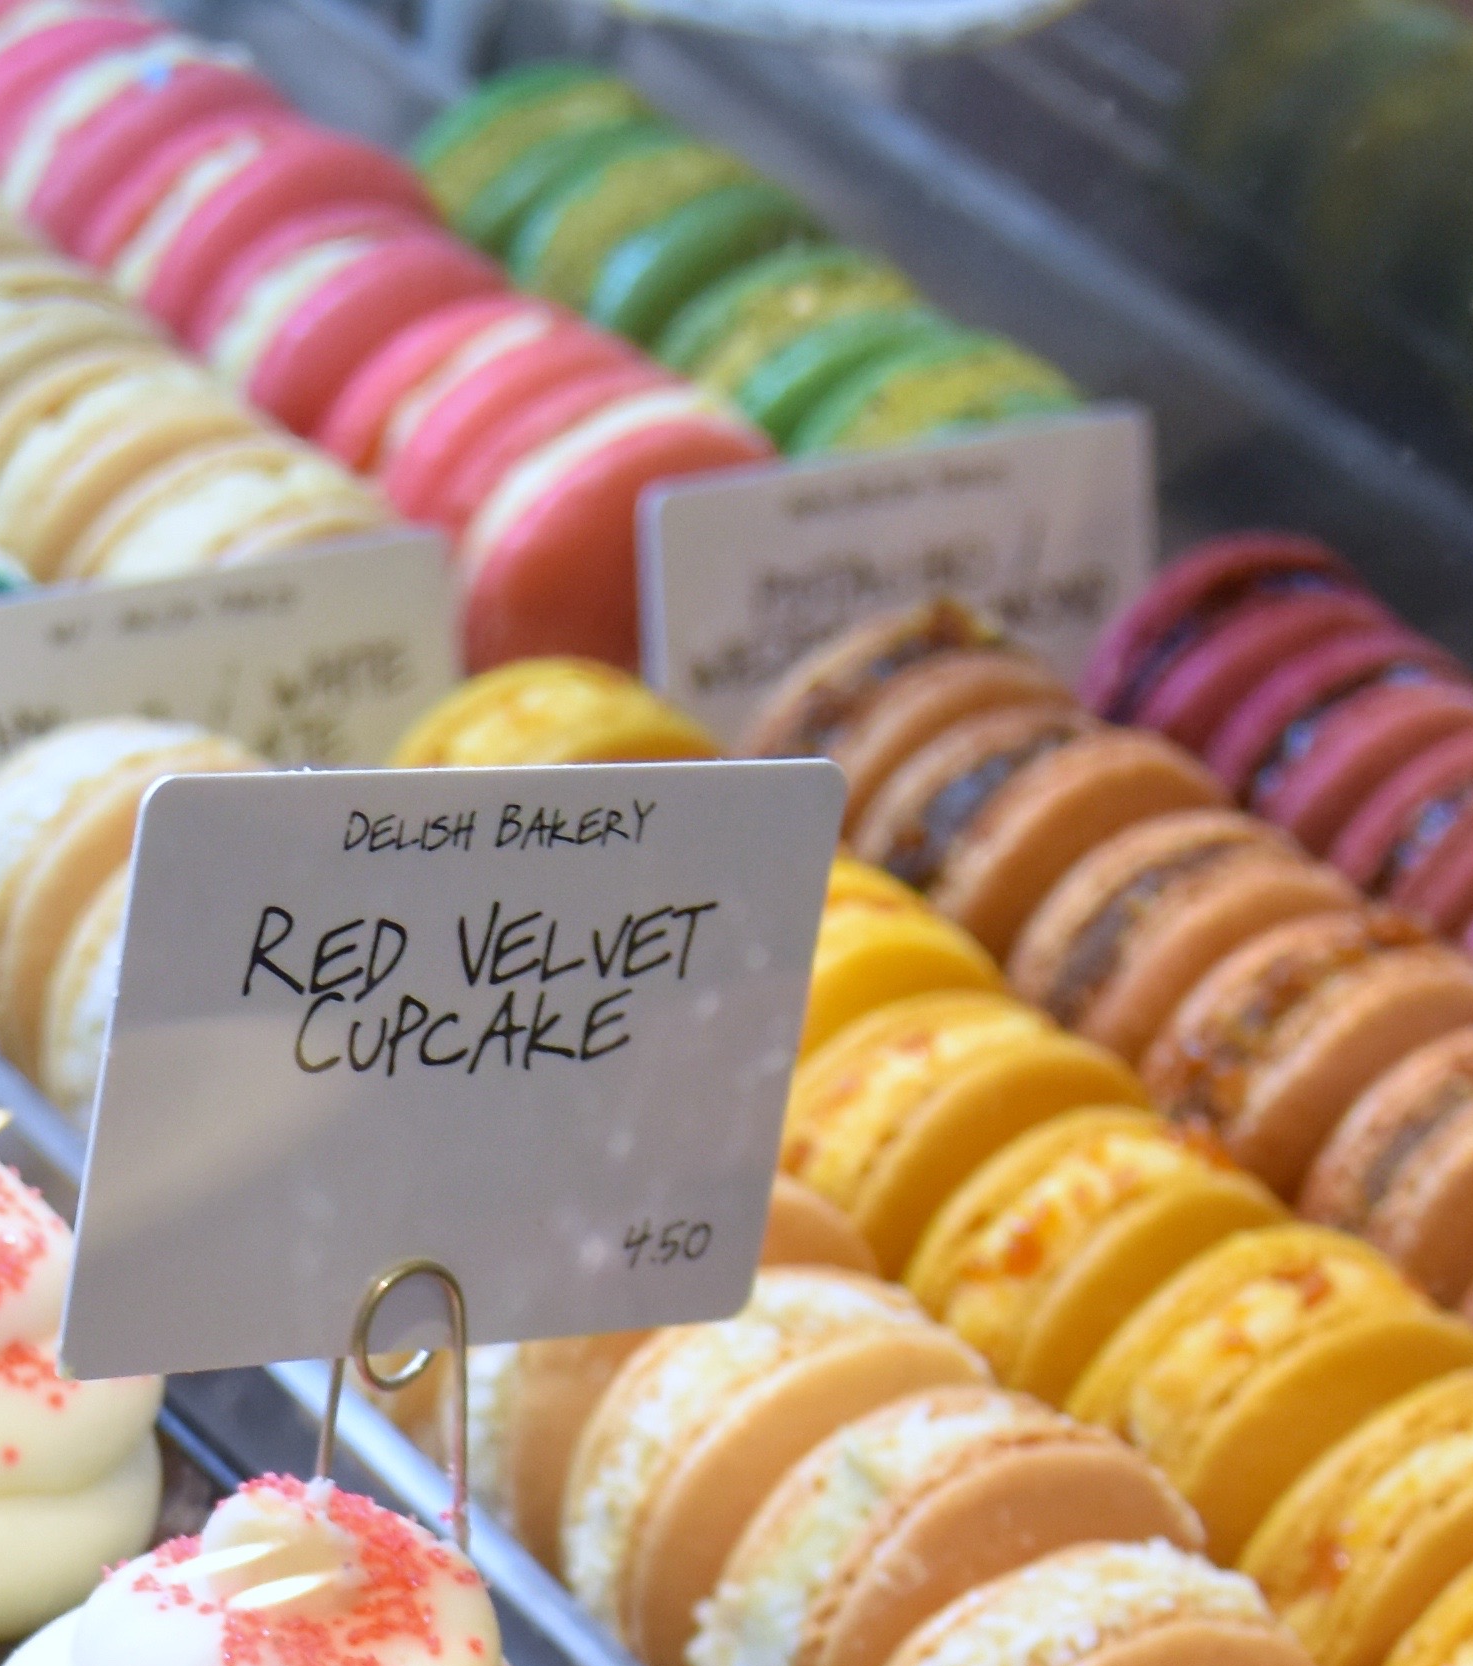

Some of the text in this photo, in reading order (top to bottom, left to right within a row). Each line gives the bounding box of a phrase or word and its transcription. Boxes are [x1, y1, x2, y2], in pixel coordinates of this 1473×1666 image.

[343, 800, 657, 852] DELISH BAKERY
[242, 900, 719, 999] RED VELVET
[294, 988, 633, 1078] CUPCAKE
[622, 1219, 714, 1269] 4.50
